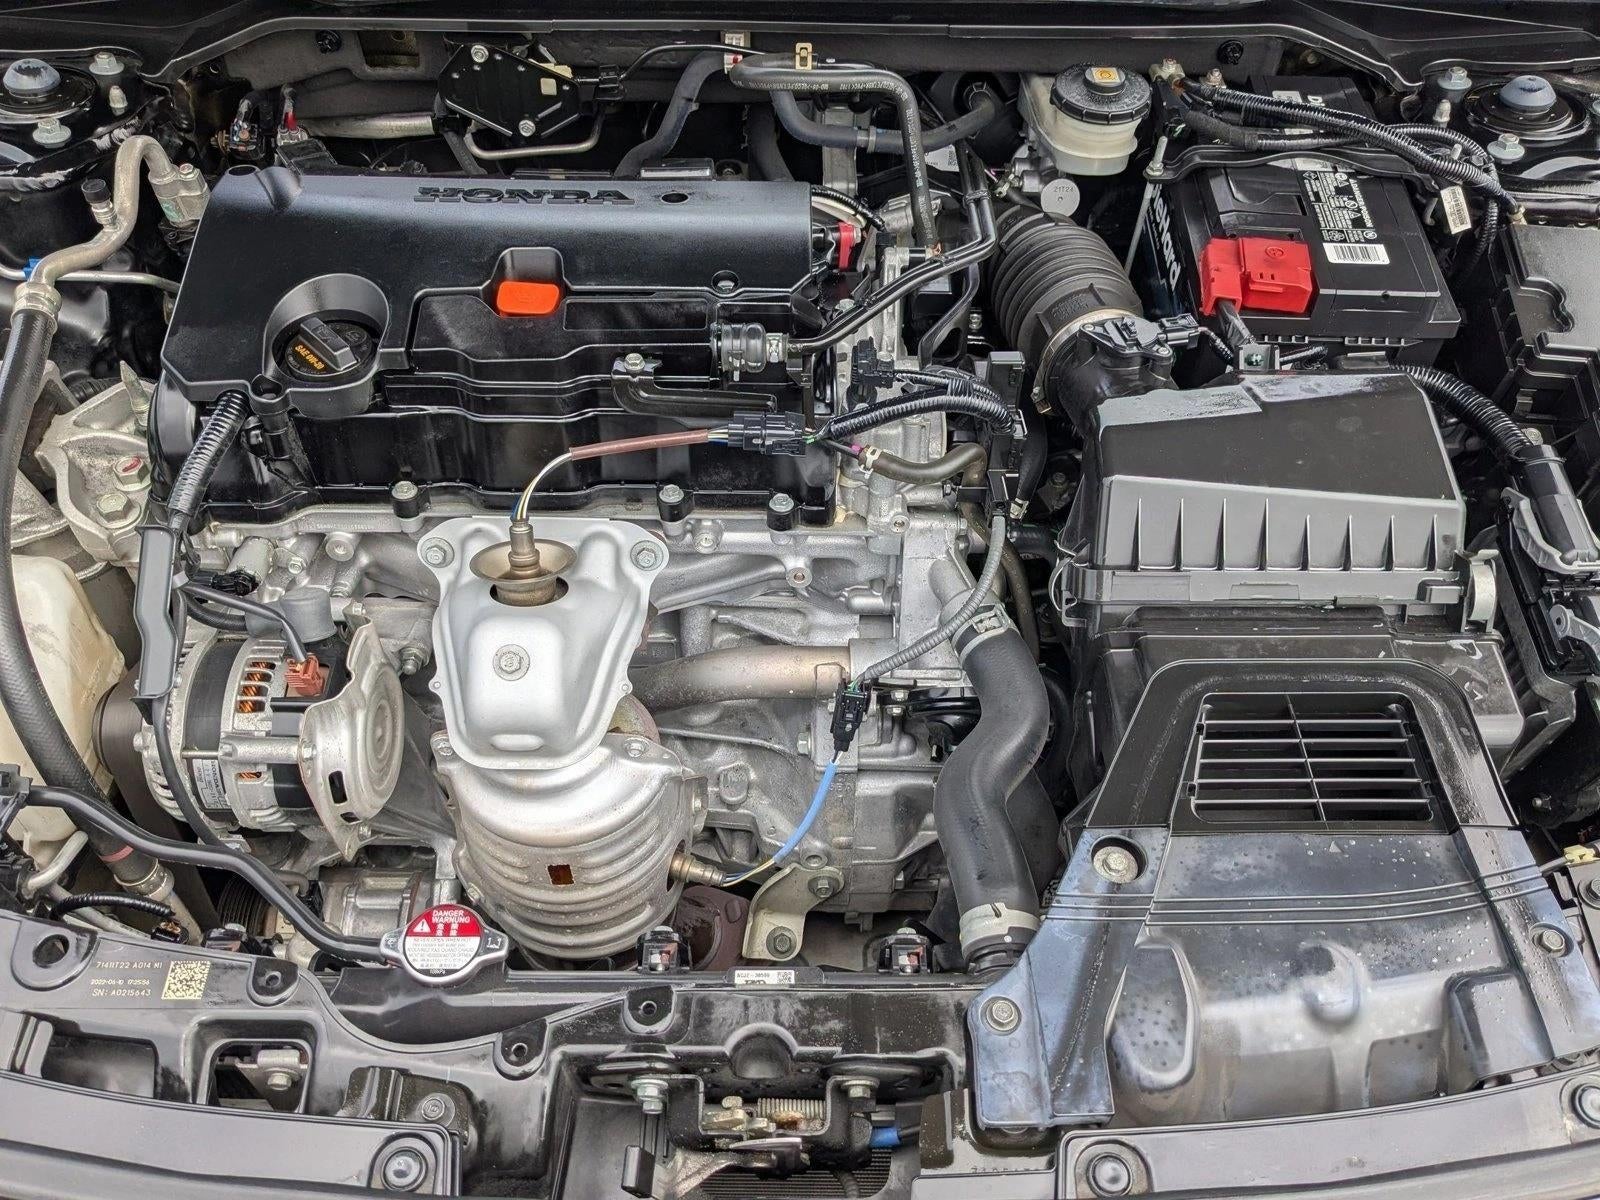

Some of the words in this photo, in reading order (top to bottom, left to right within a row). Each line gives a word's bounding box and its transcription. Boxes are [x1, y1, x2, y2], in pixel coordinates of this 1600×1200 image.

[414, 187, 635, 205] HONDA
[1153, 184, 1181, 291] ieHard
[295, 345, 310, 358] SAE
[132, 961, 151, 969] A014
[91, 988, 108, 997] SN:
[110, 988, 152, 997] A0215643
